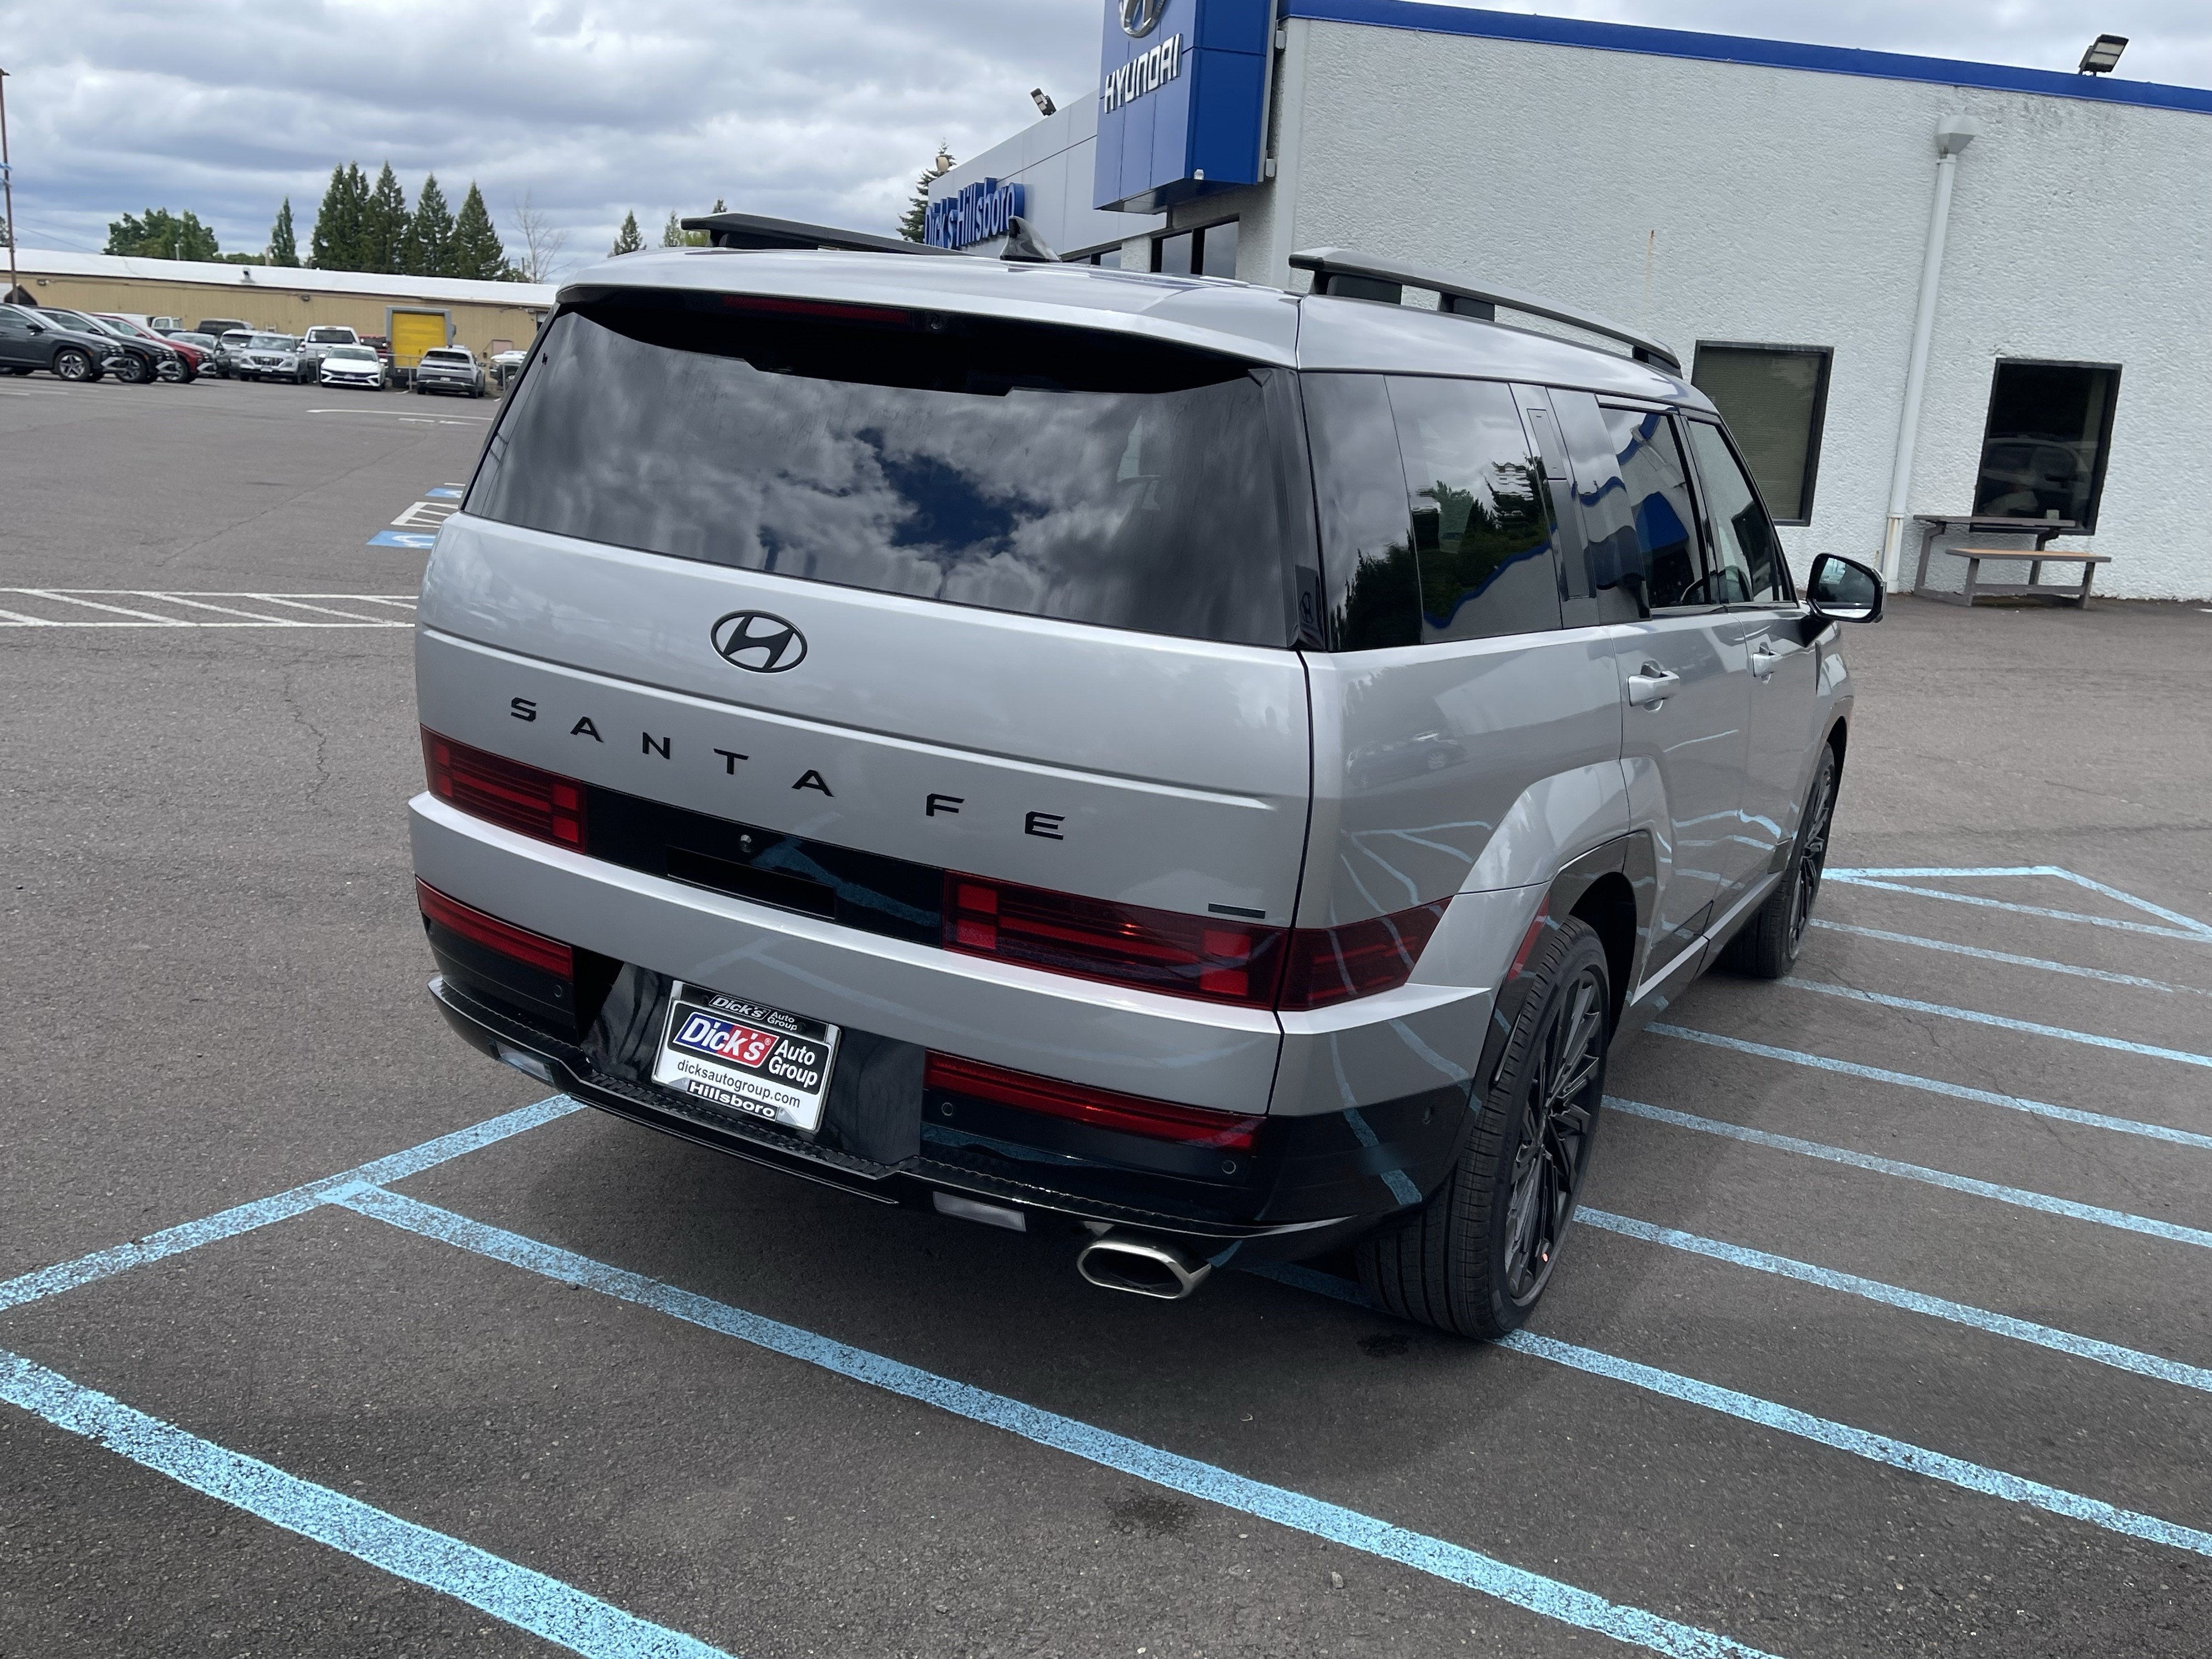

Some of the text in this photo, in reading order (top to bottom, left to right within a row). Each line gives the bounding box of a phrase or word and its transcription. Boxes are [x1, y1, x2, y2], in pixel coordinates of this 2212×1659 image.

[1104, 33, 1182, 114] HYUNDAI
[924, 177, 1015, 250] Dick's Hillsboro
[510, 696, 1066, 840] SANTA FE
[714, 996, 795, 1023] Dick's Auto
[767, 1016, 798, 1031] Group
[681, 1017, 816, 1066] Dick's Auto
[678, 1059, 801, 1108] dicksautogroup.com
[769, 1056, 818, 1088] Group
[689, 1081, 776, 1118] Hillsboro
